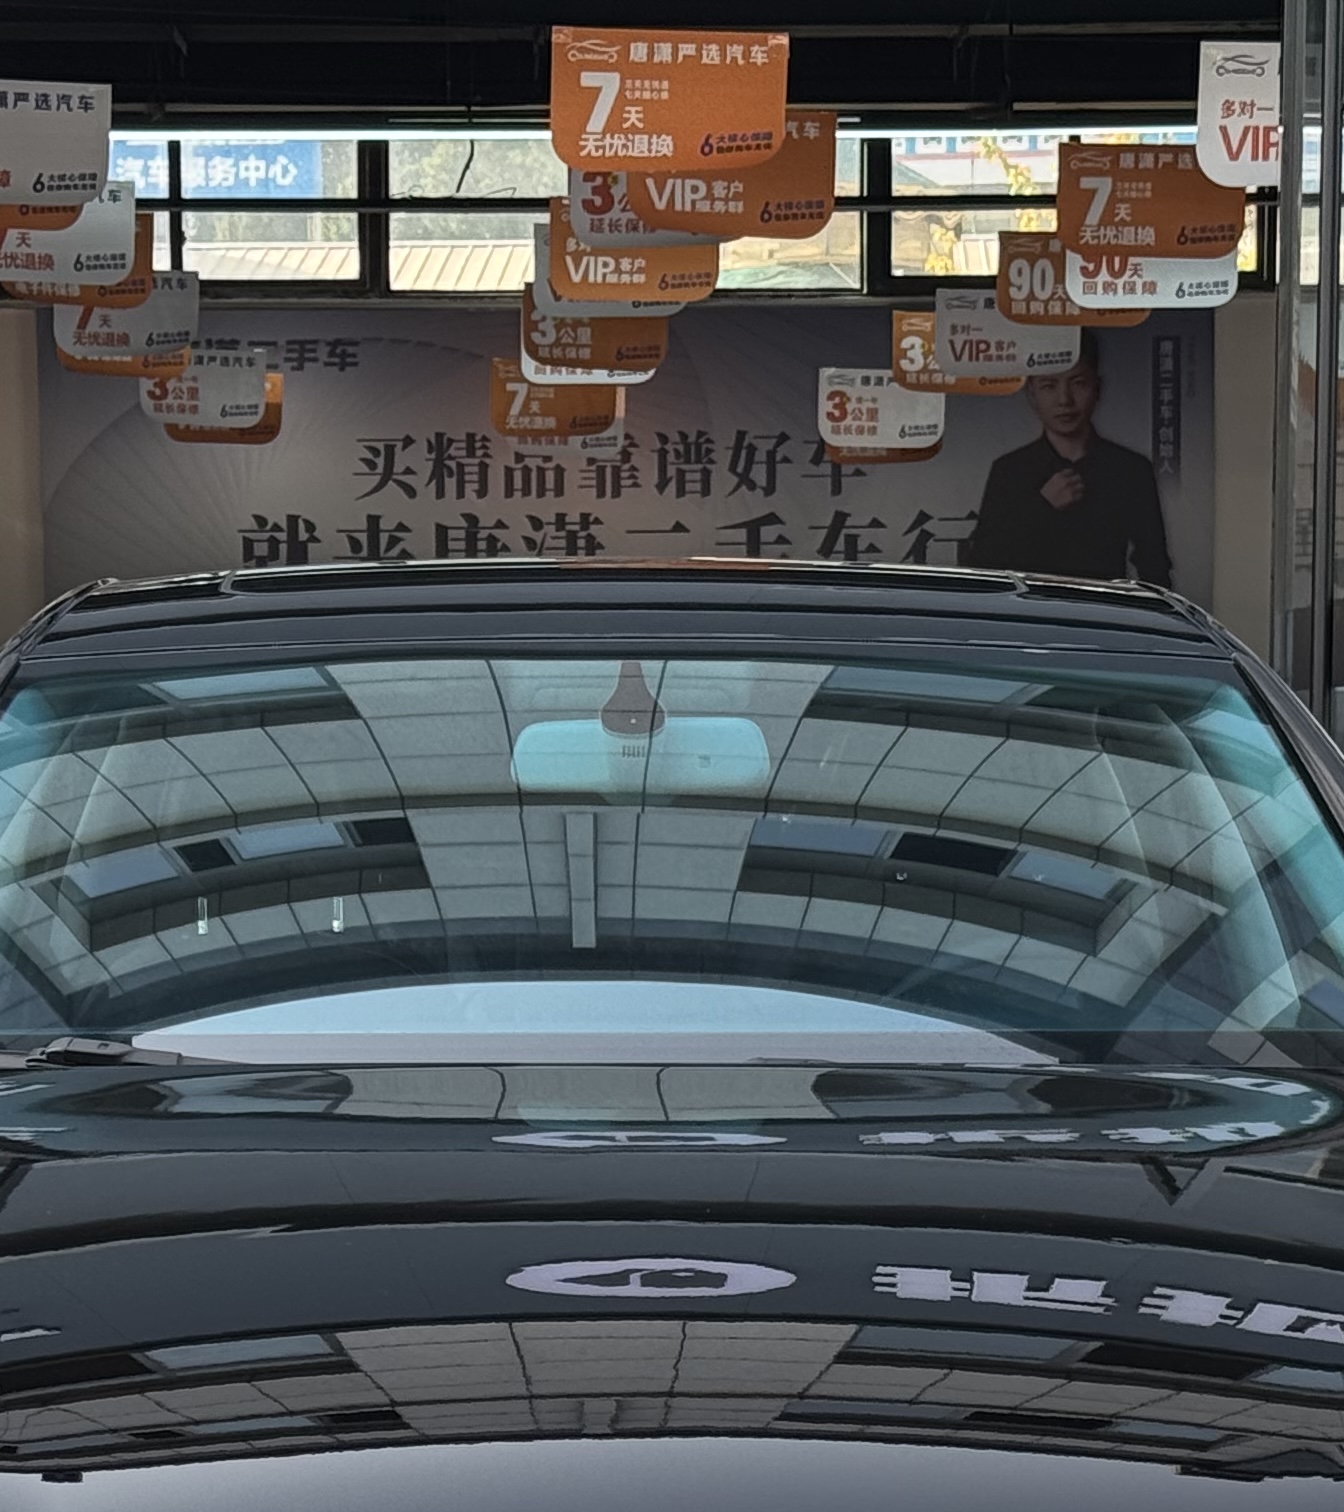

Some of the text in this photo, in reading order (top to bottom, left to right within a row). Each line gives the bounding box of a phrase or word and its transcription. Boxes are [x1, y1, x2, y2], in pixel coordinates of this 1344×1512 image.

[628, 42, 770, 66] 唐潇严选汽车
[1220, 99, 1275, 120] 多对一
[578, 133, 674, 158] 无忧退换
[645, 177, 744, 213] VIP 客户
[1079, 226, 1156, 246] 无忧退换
[564, 255, 647, 284] VIP 客户
[1082, 280, 1158, 297] 回购保障
[72, 331, 131, 347] 无忧退换
[948, 339, 992, 362] VIP
